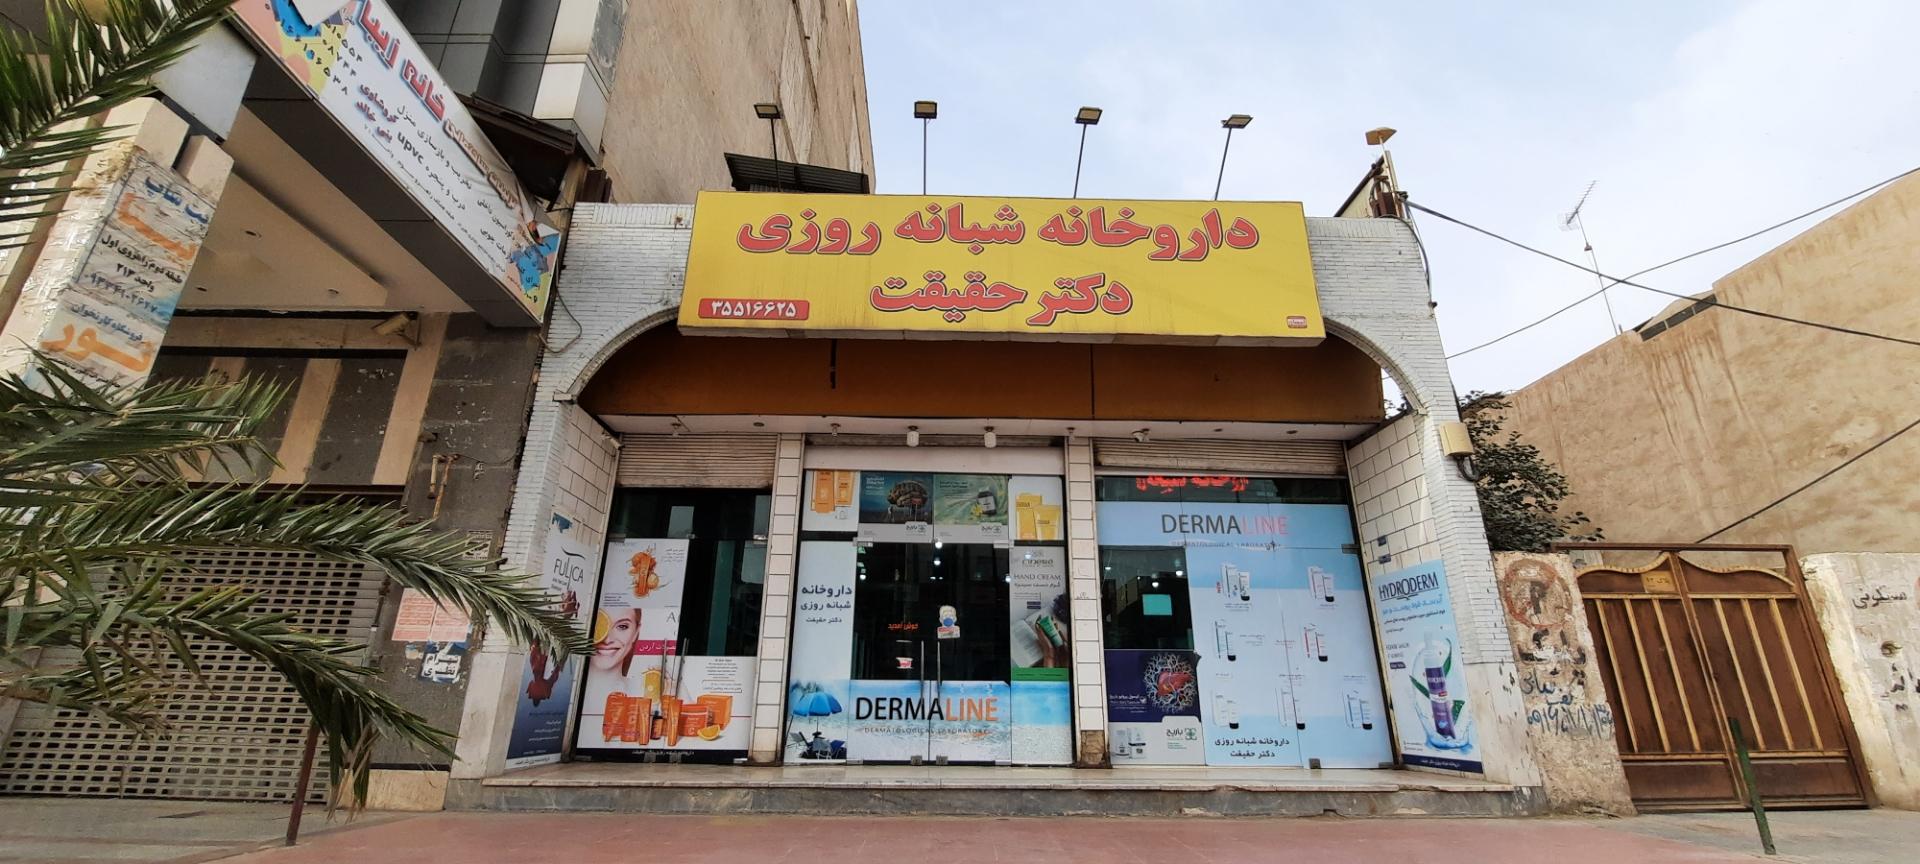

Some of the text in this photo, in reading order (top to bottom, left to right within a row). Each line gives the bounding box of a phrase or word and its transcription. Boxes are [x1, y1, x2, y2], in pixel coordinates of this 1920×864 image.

[400, 60, 446, 122] خانه
[397, 106, 416, 127] منزل
[398, 132, 423, 164] upvc
[418, 132, 444, 159] بازسازی
[452, 166, 471, 190] تخریب
[102, 235, 119, 248] اول
[736, 203, 1259, 262] داروخانه شبانه روزی
[134, 276, 154, 292] واحد
[870, 270, 1134, 326] دکتر حقیقت
[710, 300, 798, 318] ۳۵۵۱۶۶۲۵
[1161, 514, 1289, 536] DERMALINE
[554, 557, 584, 585] FULICA
[802, 584, 852, 598] داروخانه
[1378, 572, 1439, 600] HYDRODERM
[800, 600, 852, 611] شبانه روزی
[856, 697, 998, 721] DERMALINE
[864, 727, 934, 735] DERMATOLOGICAL
[1166, 728, 1184, 737] باریج
[1214, 737, 1290, 746] داروخانه شبانه روزی
[1230, 750, 1276, 759] دکتر حقیقت
